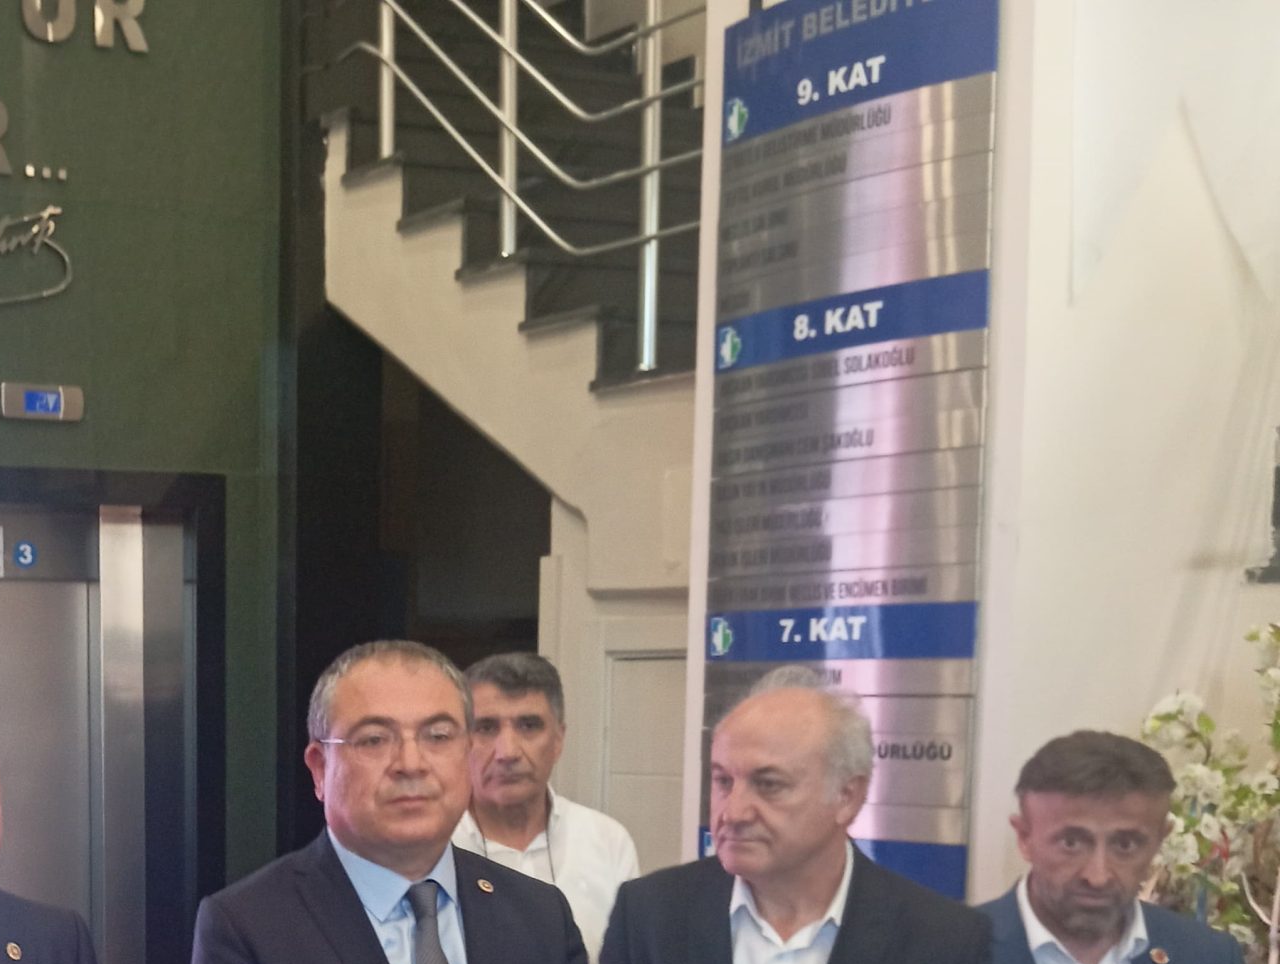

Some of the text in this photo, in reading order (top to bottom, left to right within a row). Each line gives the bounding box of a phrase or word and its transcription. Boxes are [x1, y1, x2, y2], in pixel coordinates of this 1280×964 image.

[797, 55, 886, 105] 9. KAT
[793, 300, 884, 341] 8. KAT
[18, 543, 33, 565] 3
[779, 616, 867, 643] 7. KAT
